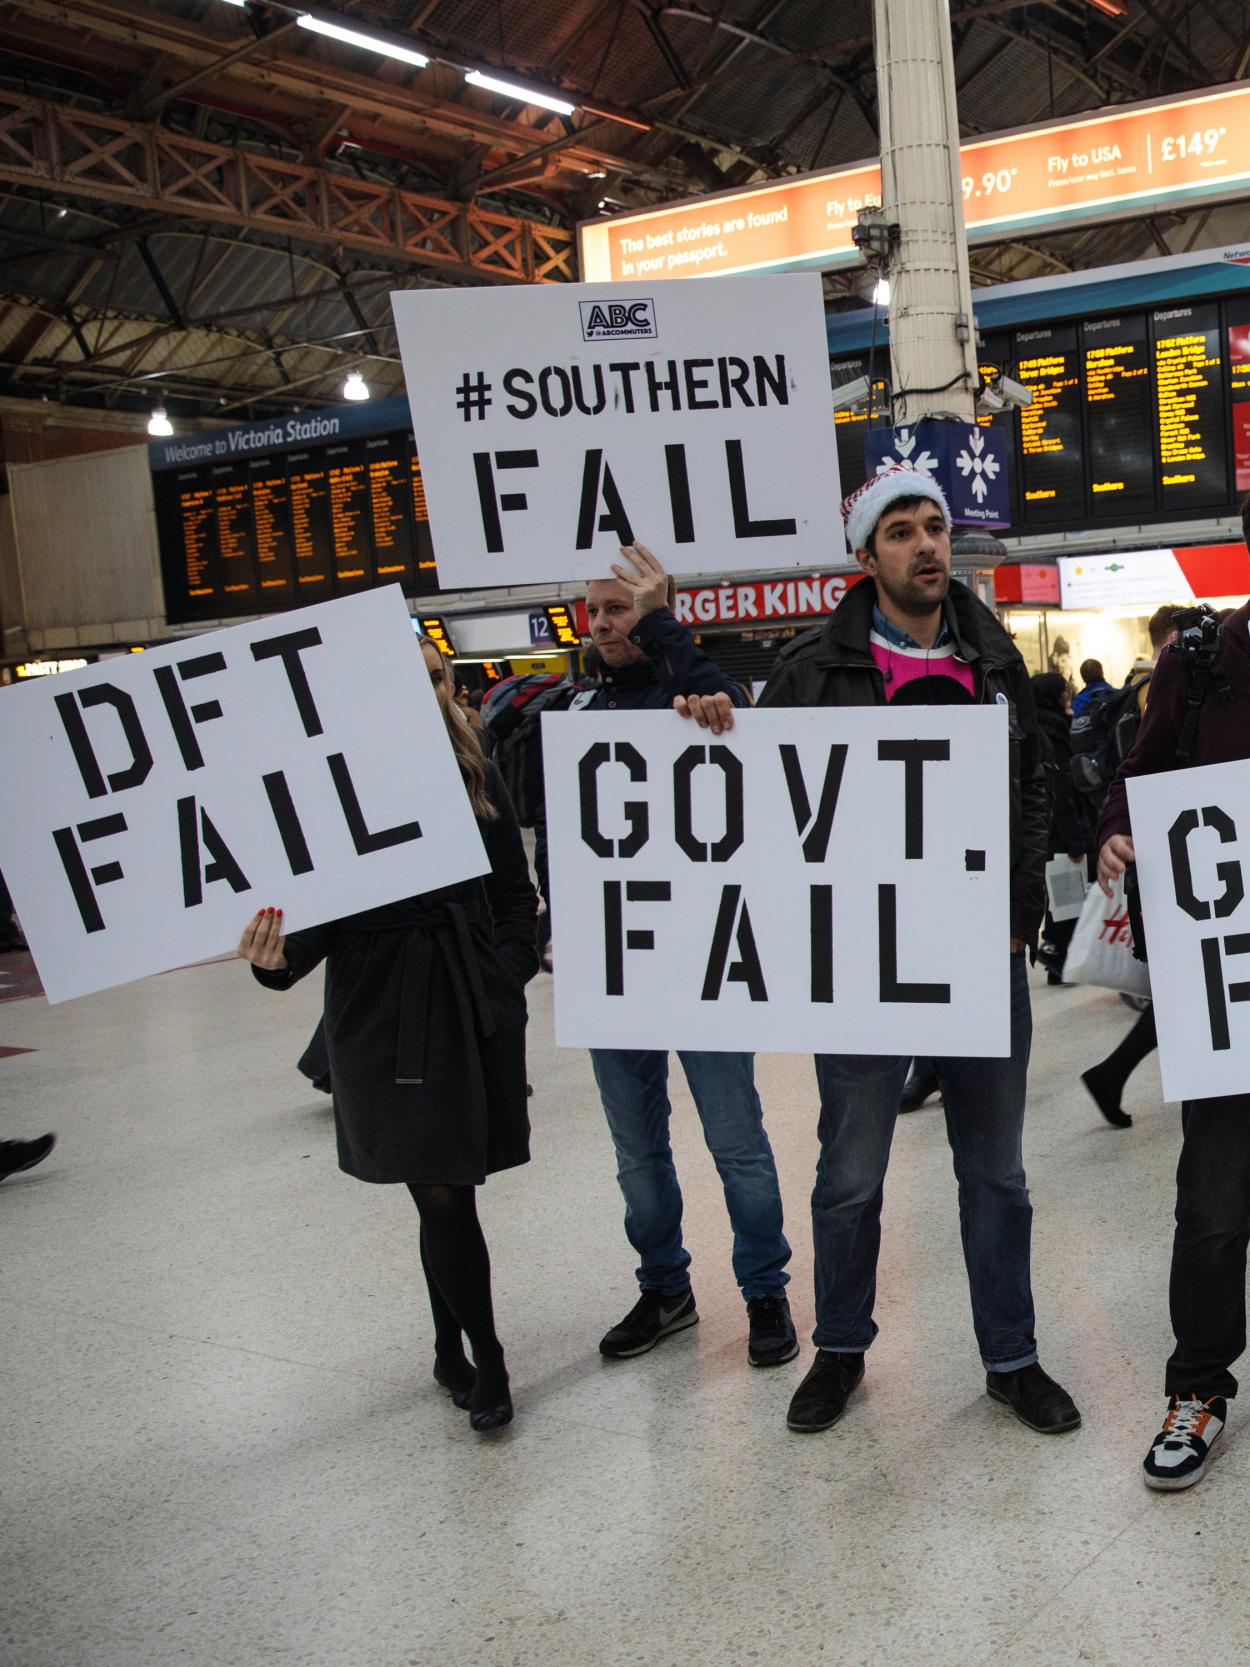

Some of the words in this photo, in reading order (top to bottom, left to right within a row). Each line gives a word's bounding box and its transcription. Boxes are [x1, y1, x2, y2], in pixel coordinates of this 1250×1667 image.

[1048, 155, 1069, 173] Fly
[1072, 153, 1088, 168] to
[1091, 144, 1122, 164] USA
[826, 201, 845, 217] Fly
[847, 196, 862, 212] to
[620, 237, 644, 255] The
[646, 231, 674, 250] best
[676, 223, 720, 244] stories
[722, 221, 745, 234] are
[747, 206, 788, 227] found
[621, 260, 635, 277] in
[635, 255, 665, 276] your
[667, 242, 728, 269] passport.
[588, 303, 650, 329] ABC
[596, 328, 652, 336] @ABCOMMUTERS
[1084, 318, 1120, 332] Departures
[1153, 308, 1192, 321] Departures
[1017, 330, 1051, 342] Departures
[456, 355, 789, 421] #SOUTHERN
[165, 440, 213, 463] Welcome
[214, 440, 227, 453] to
[227, 427, 283, 451] Victoria
[286, 416, 340, 442] Station
[473, 440, 797, 552] FAIL
[964, 507, 984, 519] Meeting
[985, 509, 999, 519] Point
[675, 586, 758, 624] RGER
[763, 578, 847, 616] KING
[531, 617, 549, 637] 12
[53, 627, 324, 799] DFT
[579, 739, 986, 872] GOVT.
[52, 752, 423, 934] FAIL
[604, 881, 951, 1004] FAIL
